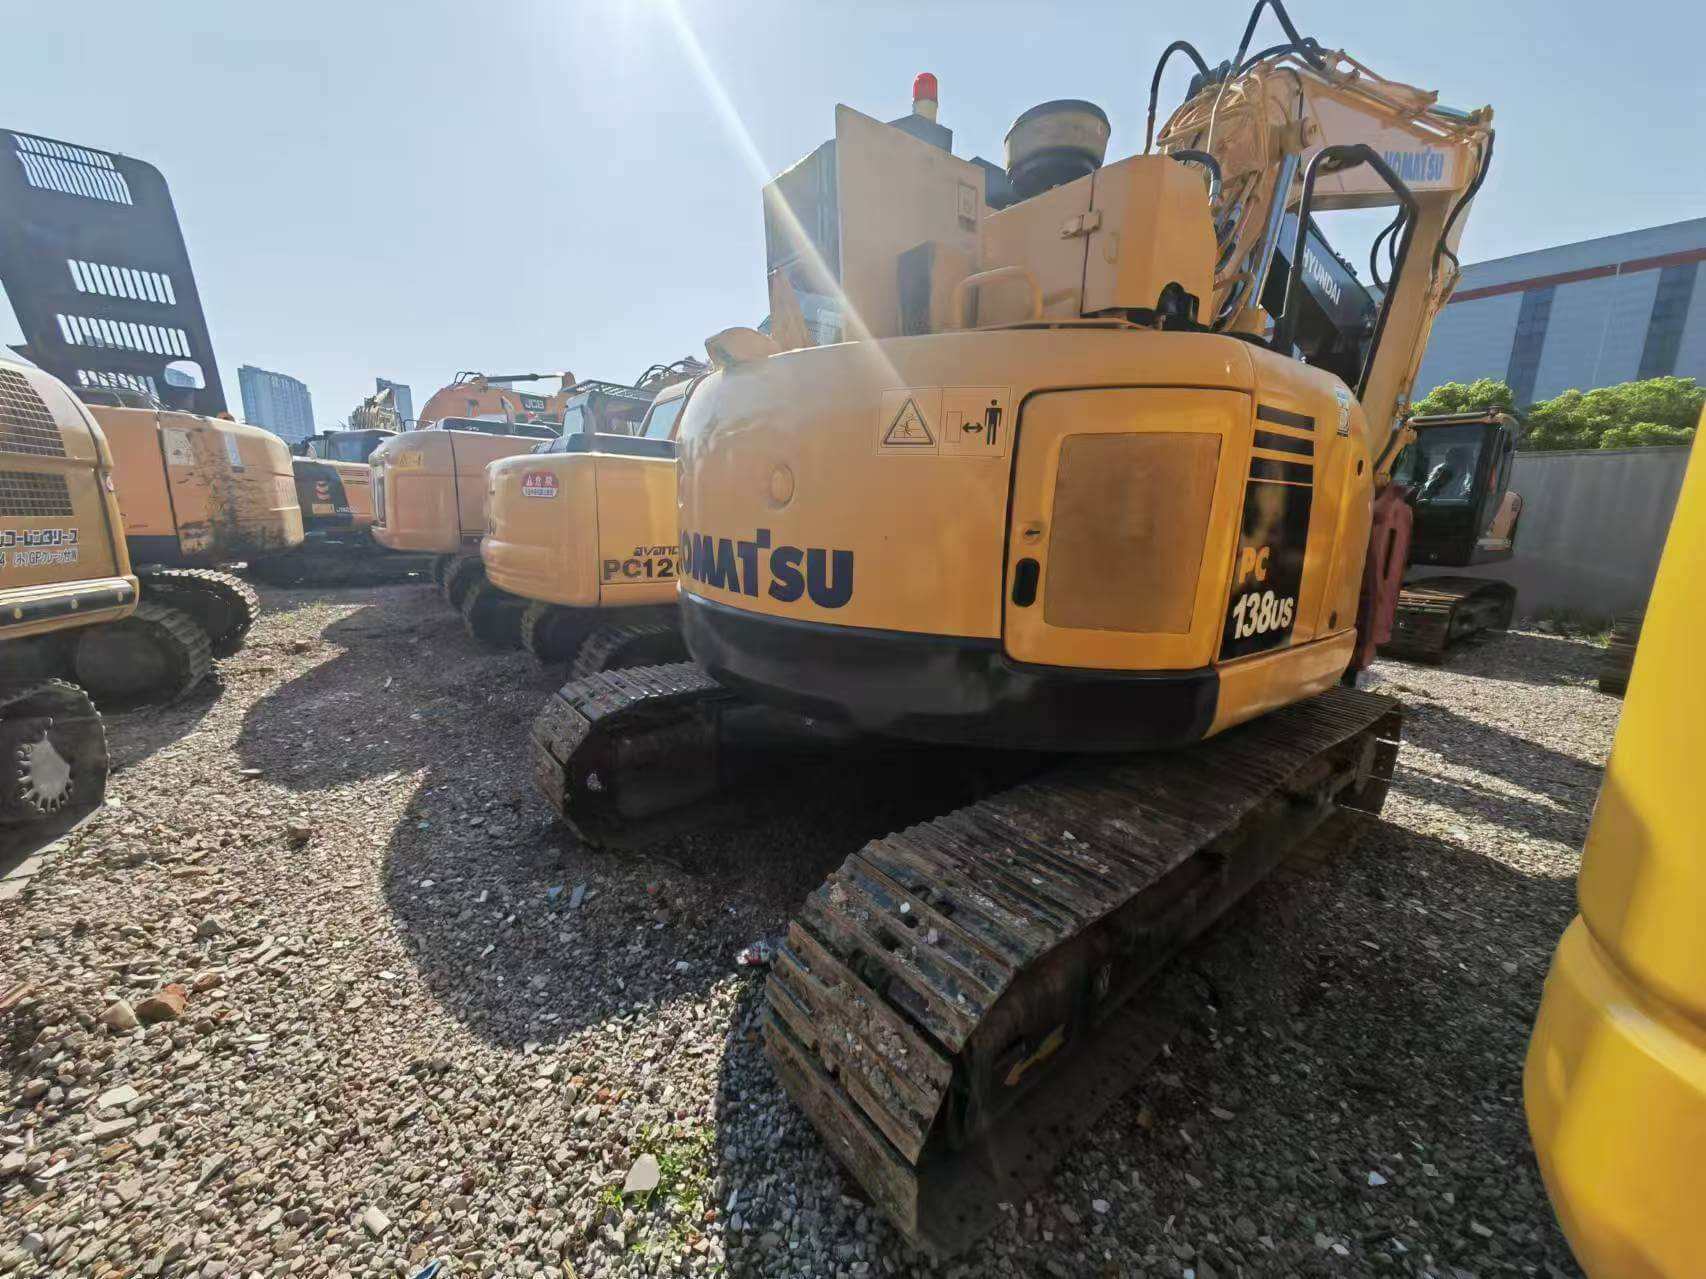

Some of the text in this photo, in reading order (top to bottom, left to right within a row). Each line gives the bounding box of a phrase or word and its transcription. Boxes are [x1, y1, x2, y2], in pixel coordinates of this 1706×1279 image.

[1302, 247, 1341, 305] HYUNDAI
[604, 559, 681, 580] PC12
[633, 545, 680, 556] avanc
[680, 528, 854, 609] OMATSU
[1239, 546, 1270, 584] PC
